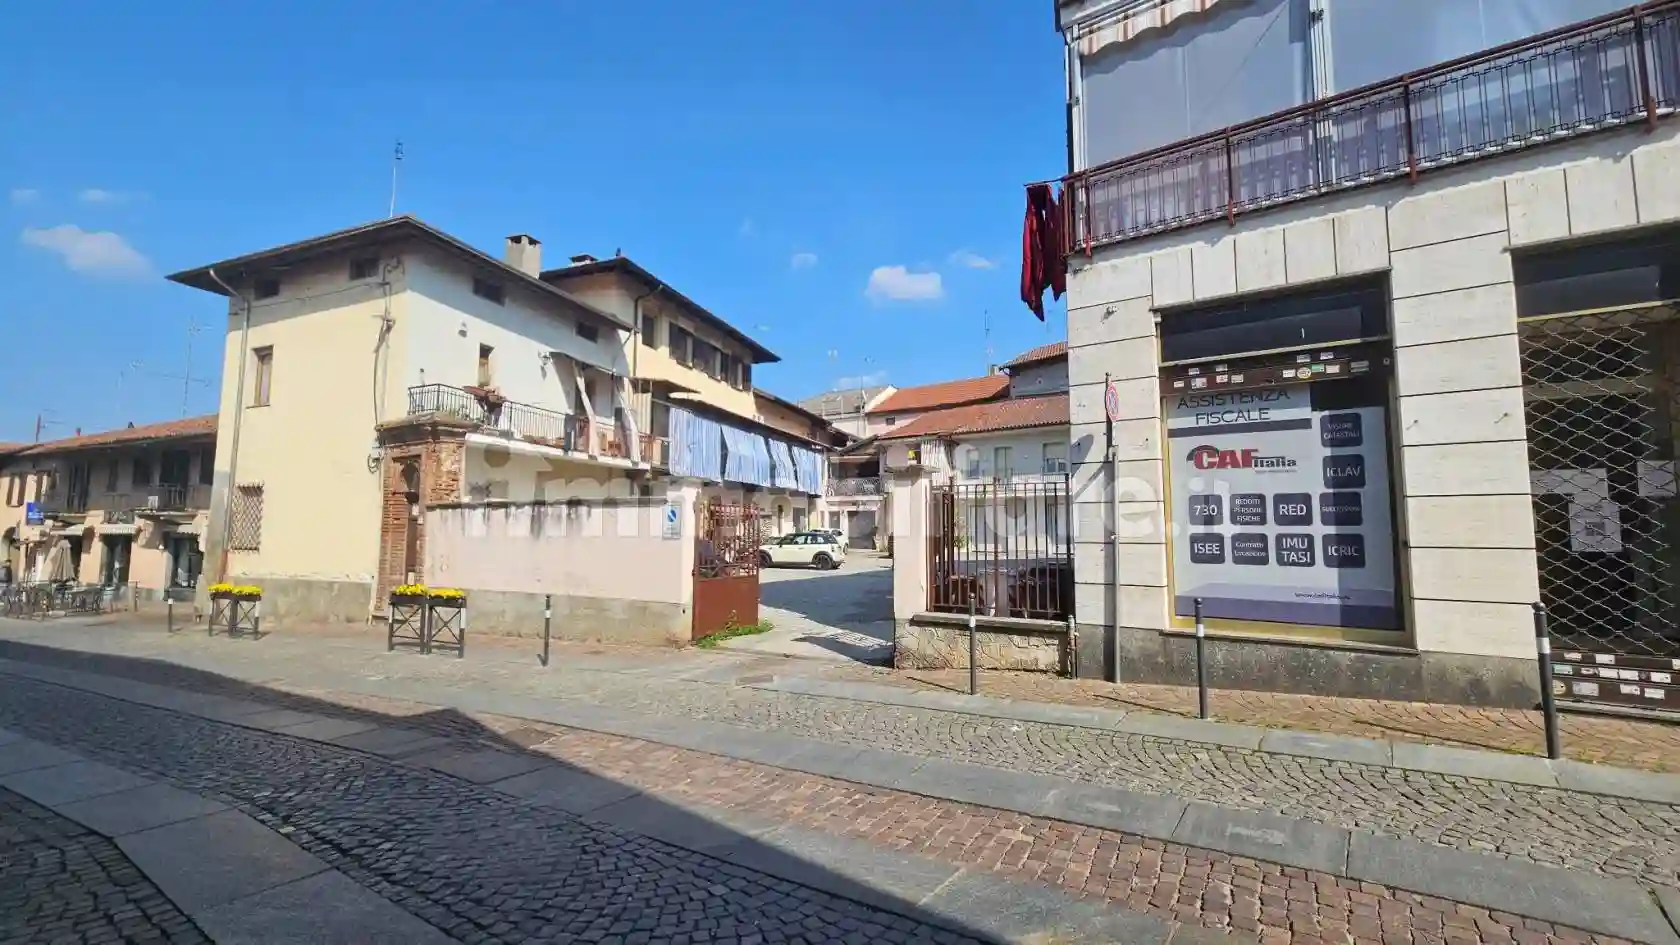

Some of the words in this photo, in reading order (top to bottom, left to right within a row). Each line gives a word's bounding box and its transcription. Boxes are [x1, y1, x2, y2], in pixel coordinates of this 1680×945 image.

[1176, 389, 1290, 410] ASSISTENZA
[1196, 407, 1271, 425] FISCALE
[1327, 466, 1361, 477] ICLAV
[1194, 505, 1218, 517] 730
[1279, 504, 1307, 516] RED
[1194, 542, 1221, 555] ISEE
[1282, 538, 1308, 550] IMU
[1327, 545, 1360, 556] ICRIC
[1282, 551, 1311, 564] TASI
